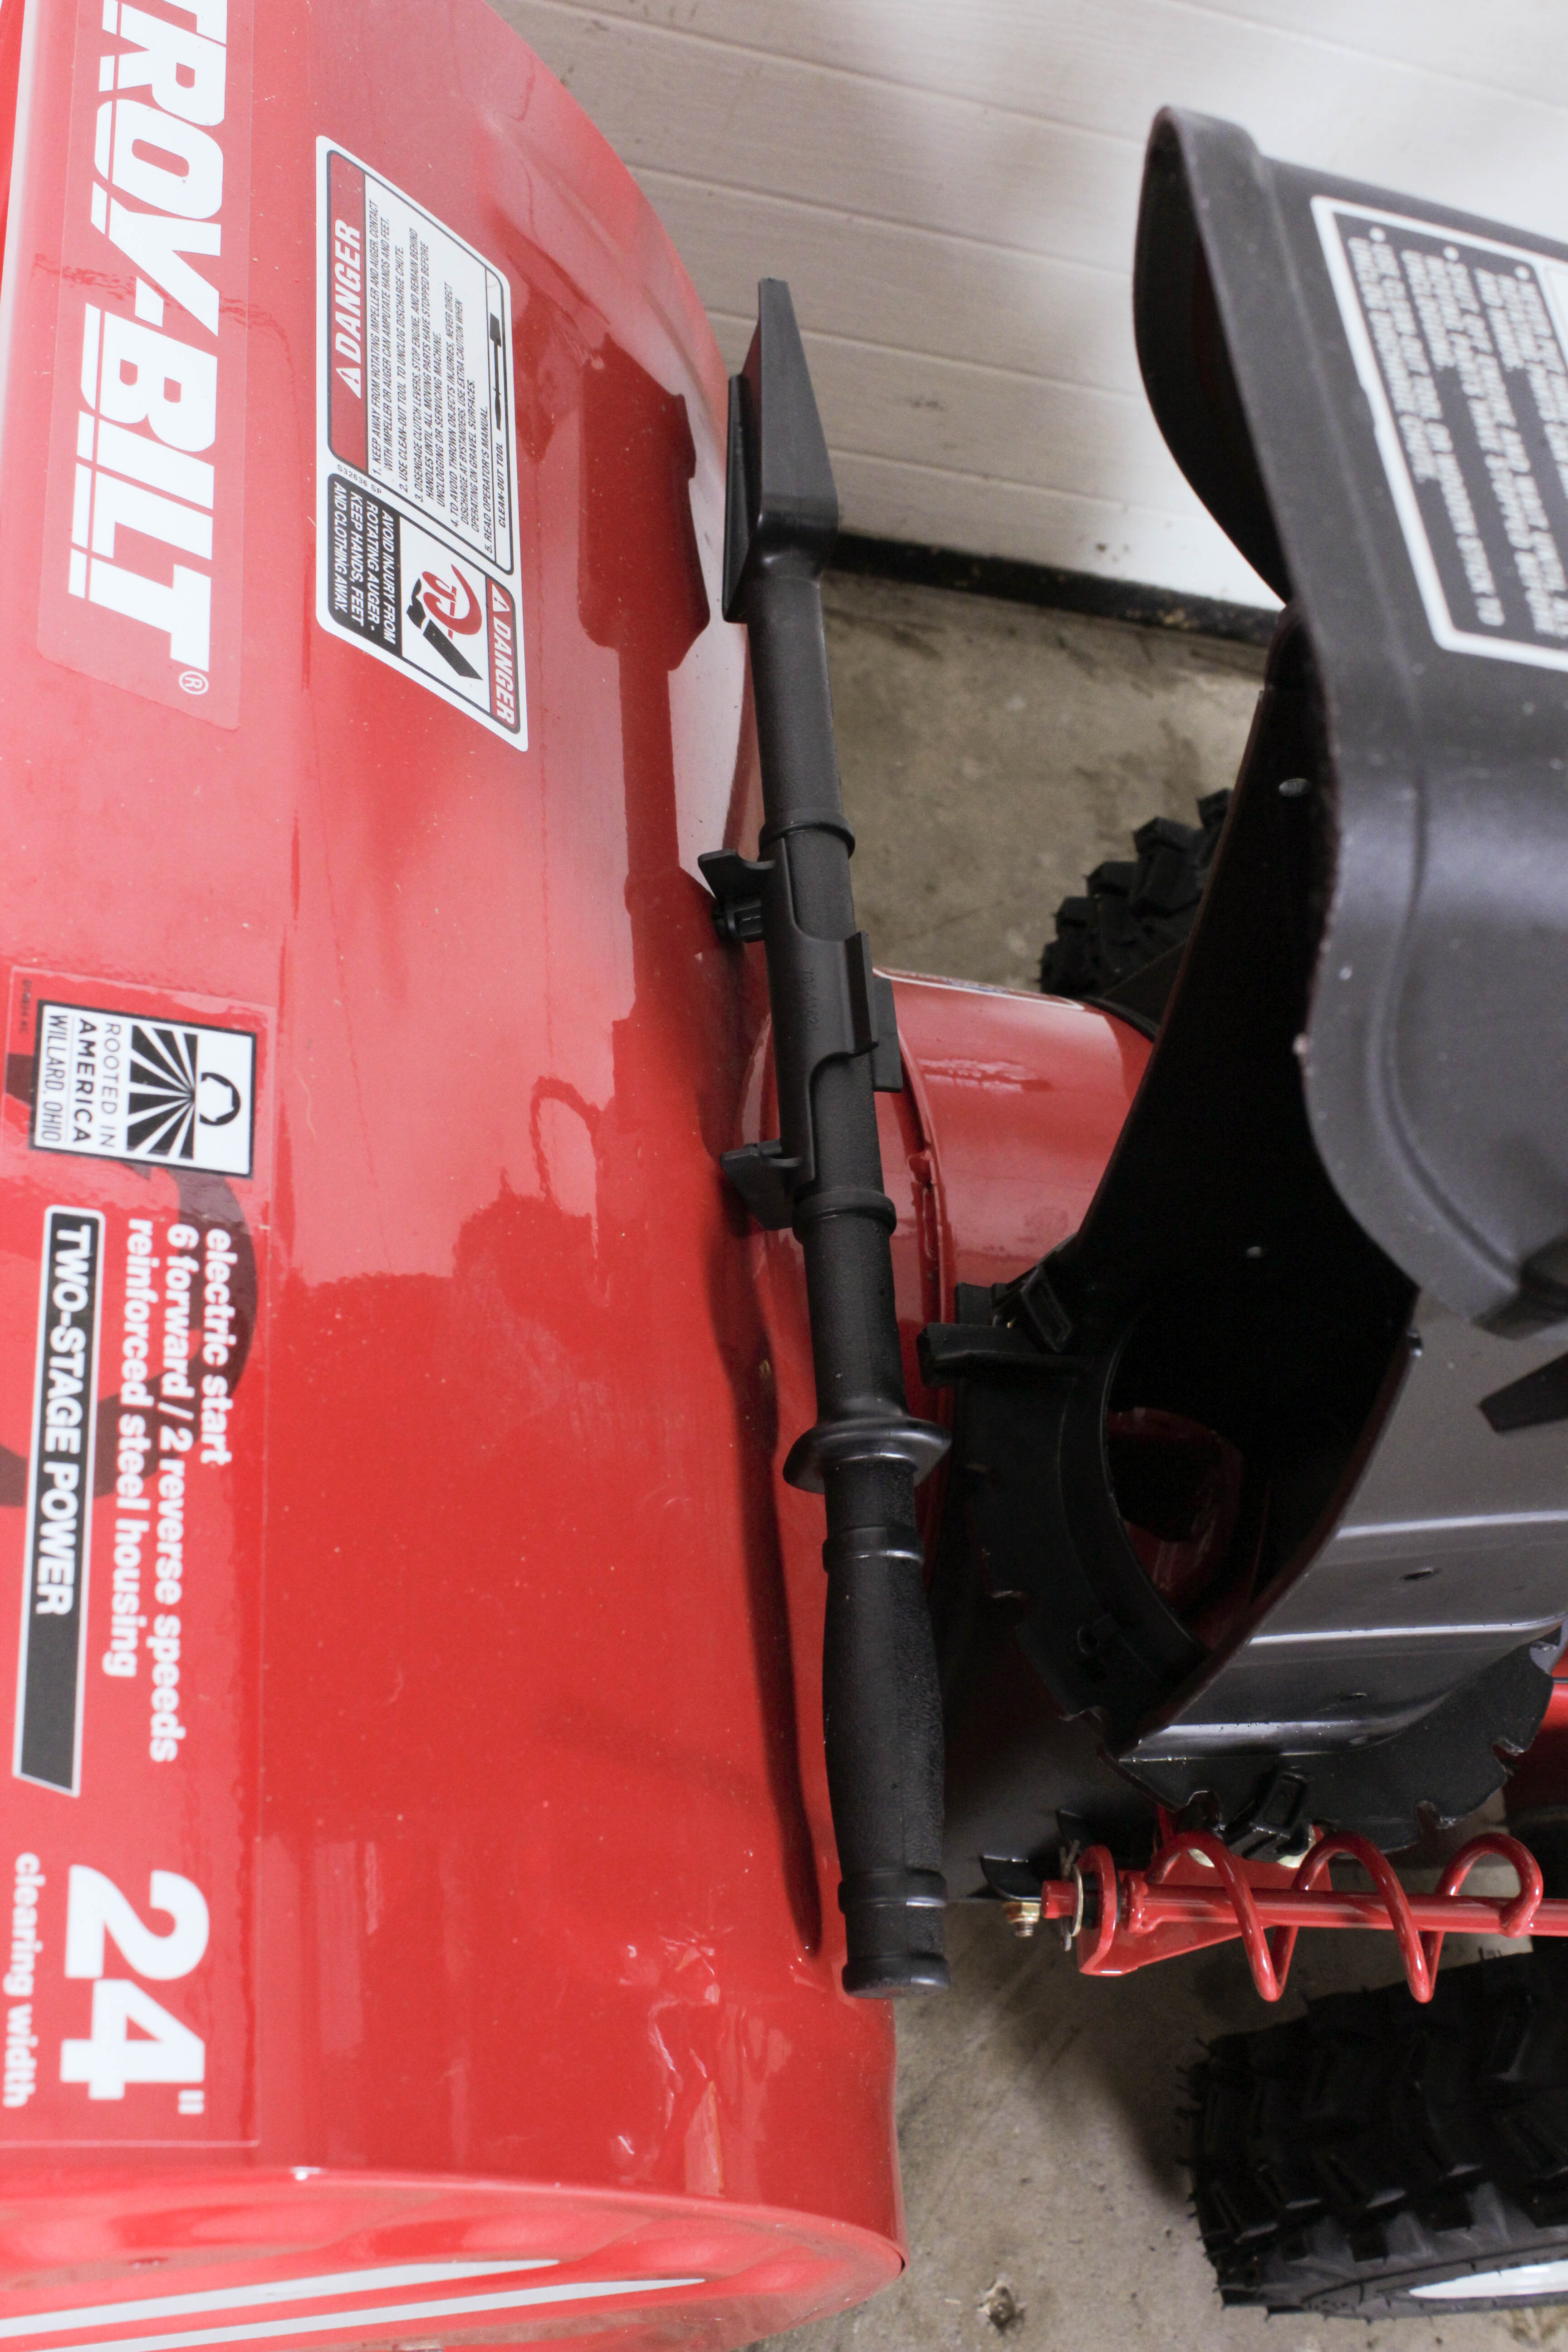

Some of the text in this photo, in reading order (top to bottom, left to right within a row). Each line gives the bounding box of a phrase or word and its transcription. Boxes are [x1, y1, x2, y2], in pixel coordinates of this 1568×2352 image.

[369, 200, 378, 239] CONTACT
[370, 240, 379, 270] AUGER.
[410, 228, 418, 259] BEHIND
[335, 219, 361, 364] DANGER
[370, 270, 379, 288] AND
[410, 260, 418, 294] REMAIN
[444, 282, 453, 312] DIRECT
[370, 288, 379, 333] IMPELLER
[411, 294, 419, 314] AND
[445, 311, 454, 339] NEVER
[455, 298, 463, 324] WHEN
[380, 217, 392, 471] WITH IMPELLER OR AUGER CAN AMPUTATE HANDS AND FEET.
[412, 316, 420, 348] ENGINE,
[456, 324, 464, 361] CAUTION
[371, 335, 380, 379] ROTATING
[395, 246, 408, 492] 2. USE CLEAN-OUT TOOL TO UNCLOG DISCHARGE CHUTE.
[412, 347, 421, 369] STOP
[420, 241, 434, 500] HANDLES UNTIL ALL MOVING PARTS HAVE STOPPED BEFORE
[446, 342, 455, 386] INJURIES,
[371, 382, 380, 407] FROM
[412, 373, 421, 407] LEVERS,
[447, 385, 456, 427] OBJECTS
[457, 387, 466, 407] USE
[372, 409, 381, 436] AWAY
[413, 407, 421, 441] CLUTCH
[433, 331, 445, 507] UNCLOGGING OR SERVICING MACHINE.
[458, 408, 467, 462] BYSTANDERS.
[480, 407, 489, 448] MANUAL.
[372, 438, 381, 464] KEEP
[414, 442, 423, 492] DISENGAGE
[448, 427, 457, 471] THROWN
[460, 463, 467, 475] AT
[467, 380, 480, 533] OPERATING ON GRAVEL SURFACES.
[337, 464, 382, 494] S32636 SP
[449, 471, 458, 503] AVOID
[460, 476, 469, 525] DISCHARGE
[481, 450, 491, 512] OPERATOR'S
[497, 468, 505, 528] CLEAN-OUT
[450, 502, 458, 516] TO
[334, 483, 348, 611] AND CLOTHING AWAY.
[367, 501, 379, 572] ROTATING
[485, 544, 492, 554] 5.
[350, 492, 363, 627] KEEP HANDS, FEET
[382, 510, 396, 645] AVOID INJURY FROM
[368, 571, 379, 621] AUGER
[493, 617, 514, 725] DANGER
[73, 1018, 98, 1142] AMERICA
[99, 1022, 121, 1148] ROOTED IN
[41, 1101, 64, 1142] OHIO
[167, 1223, 199, 1250] 6
[161, 1255, 199, 1398] forward
[200, 1227, 238, 1465] electric start
[35, 1225, 92, 1615] TWO-STAGE POWER
[159, 1425, 193, 1452] 2
[102, 1219, 159, 1678] reinforced steel housing
[155, 1457, 185, 1605] reverse
[146, 1614, 186, 1762] speeds
[3, 1852, 46, 2107] clearing width
